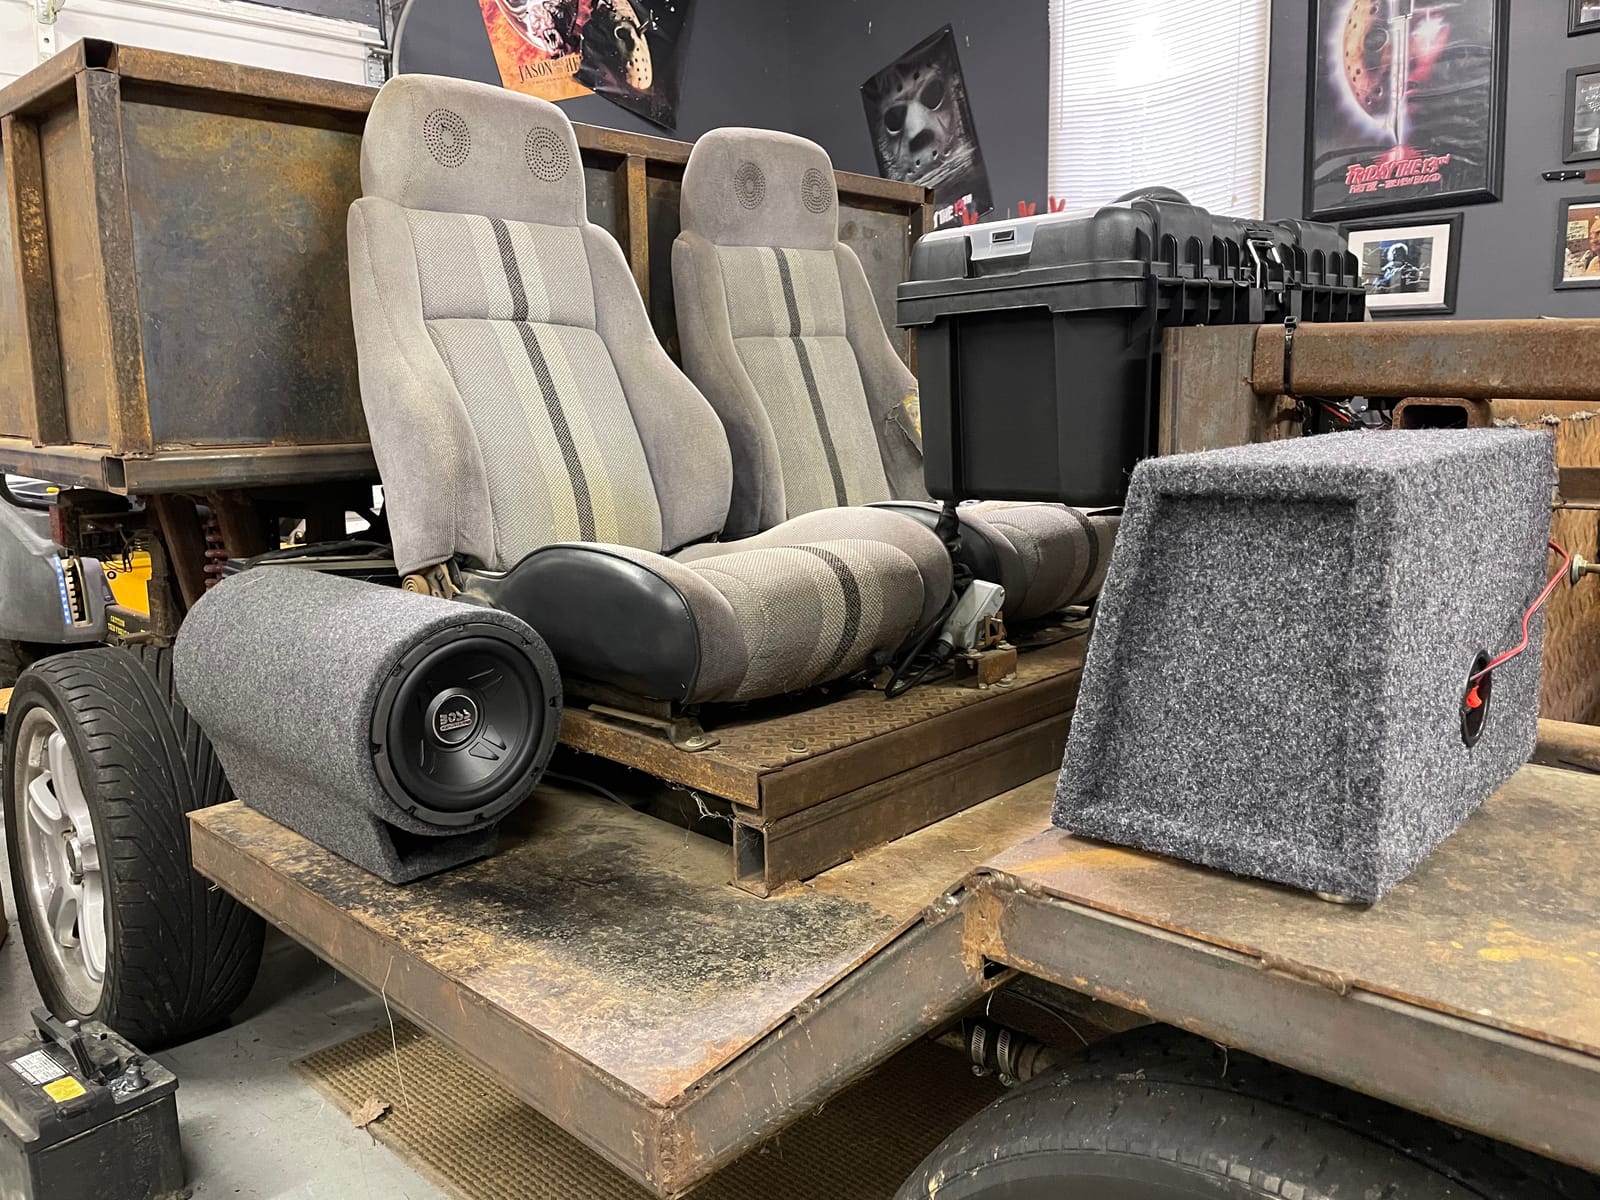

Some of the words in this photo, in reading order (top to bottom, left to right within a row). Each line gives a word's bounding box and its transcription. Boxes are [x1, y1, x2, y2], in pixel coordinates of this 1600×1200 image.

[518, 61, 553, 84] JASON
[1345, 160, 1395, 185] FRIDAY
[1394, 159, 1421, 177] THE
[440, 708, 471, 726] BOSS
